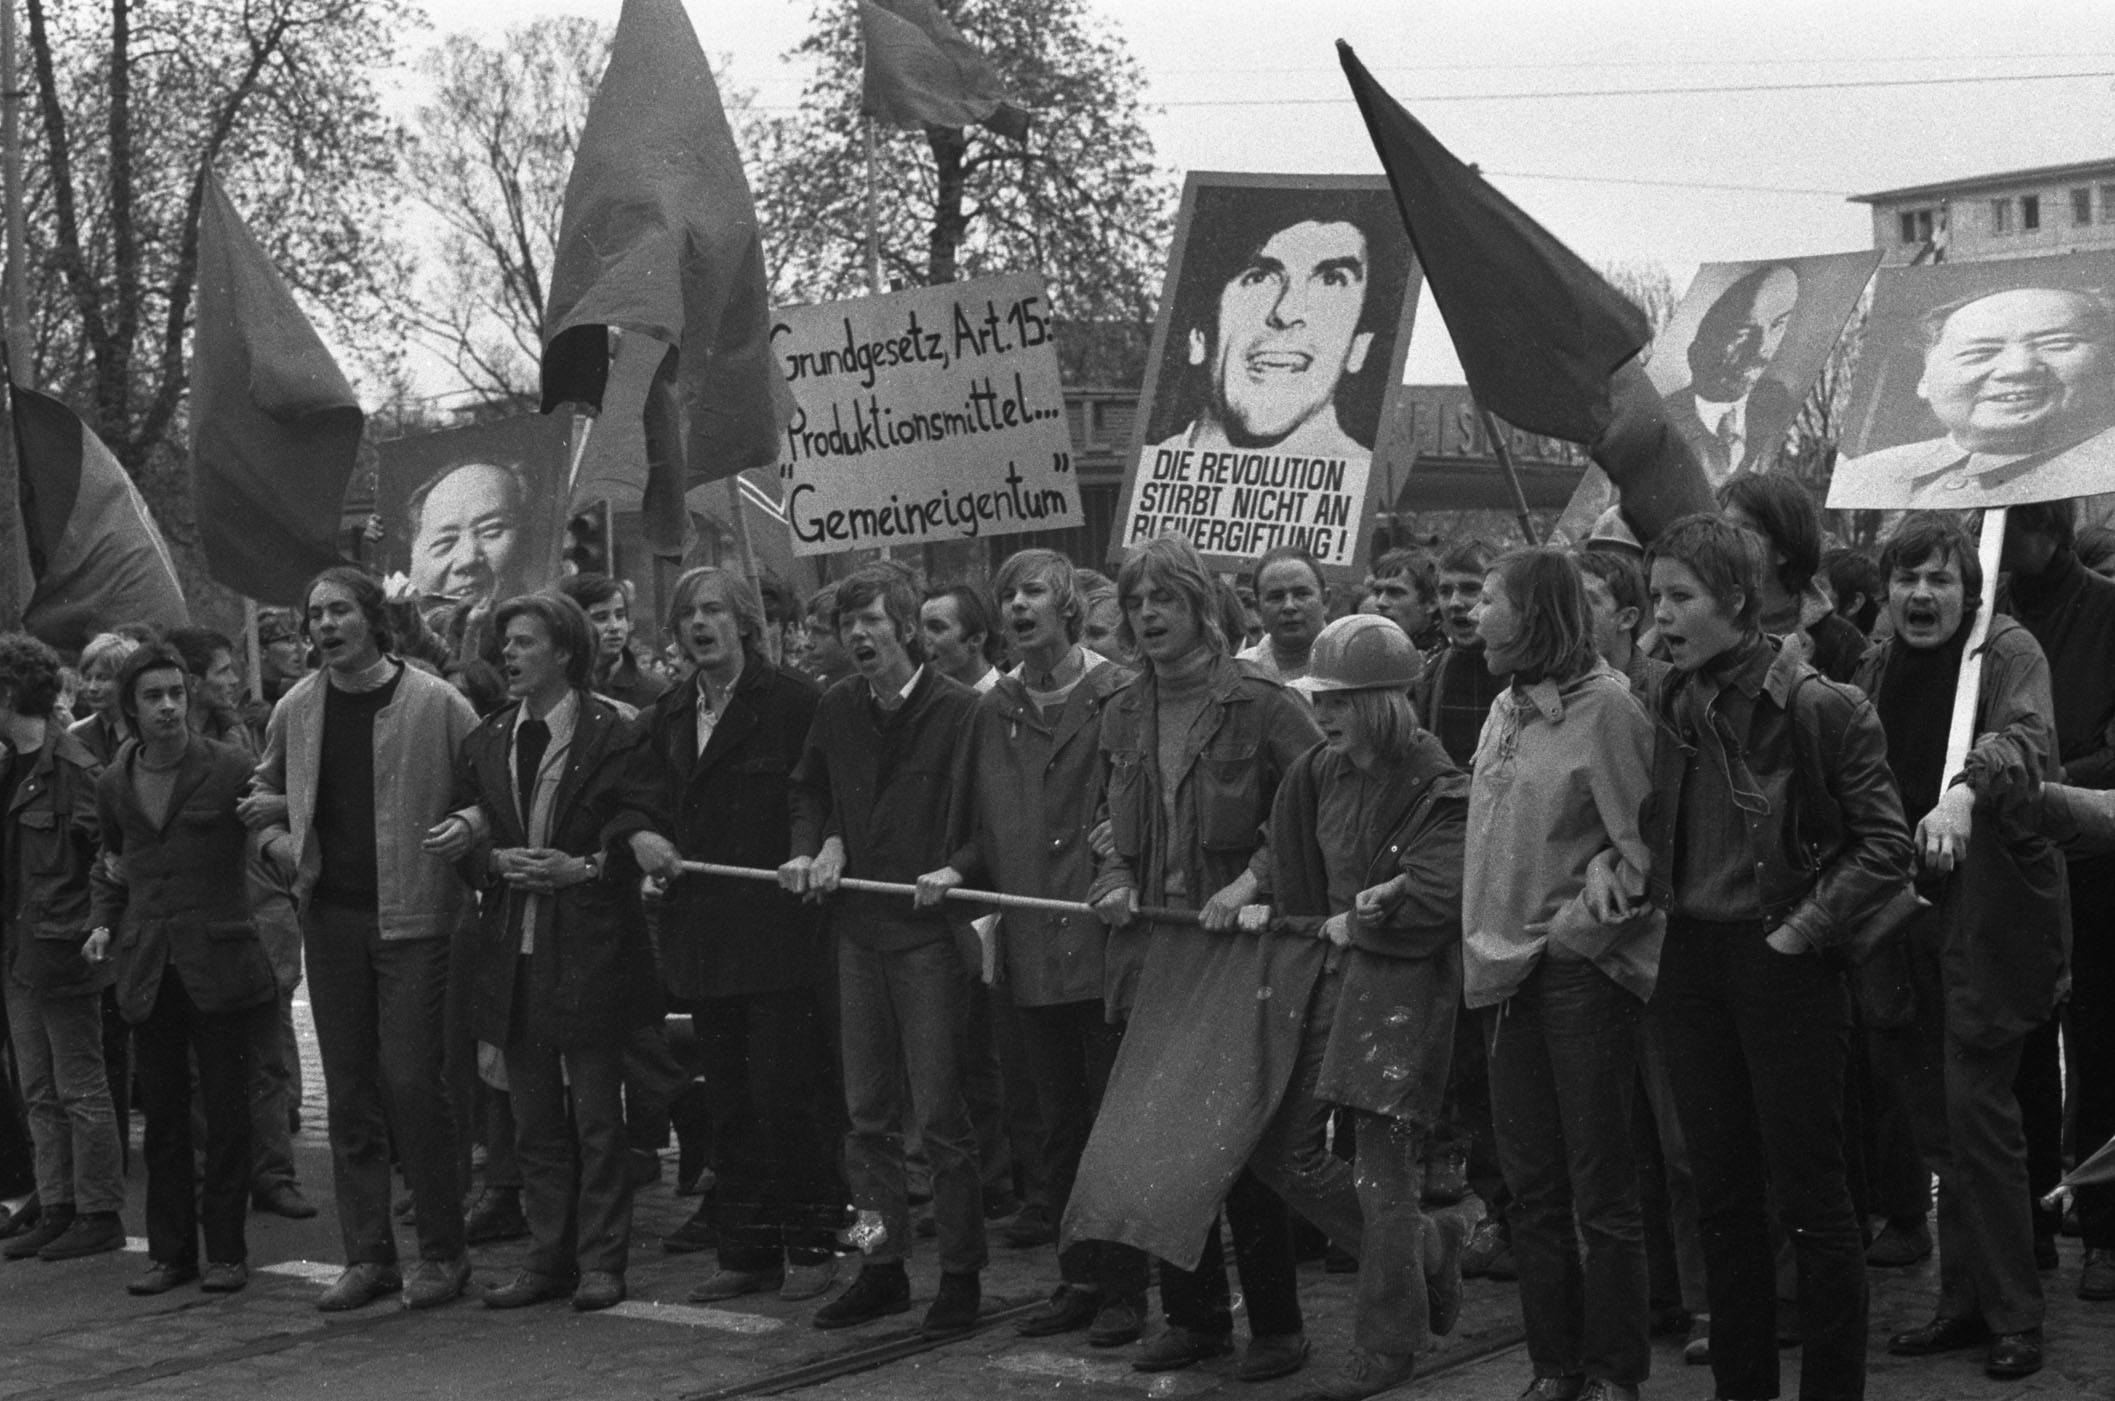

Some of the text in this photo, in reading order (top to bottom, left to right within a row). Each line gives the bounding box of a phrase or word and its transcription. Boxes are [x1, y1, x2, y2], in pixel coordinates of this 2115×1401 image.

[787, 372, 1059, 461] Produktionsmittel...
[1153, 449, 1346, 492] DIE REVOLUTION
[1139, 483, 1352, 527] STIRBT NICHT AN
